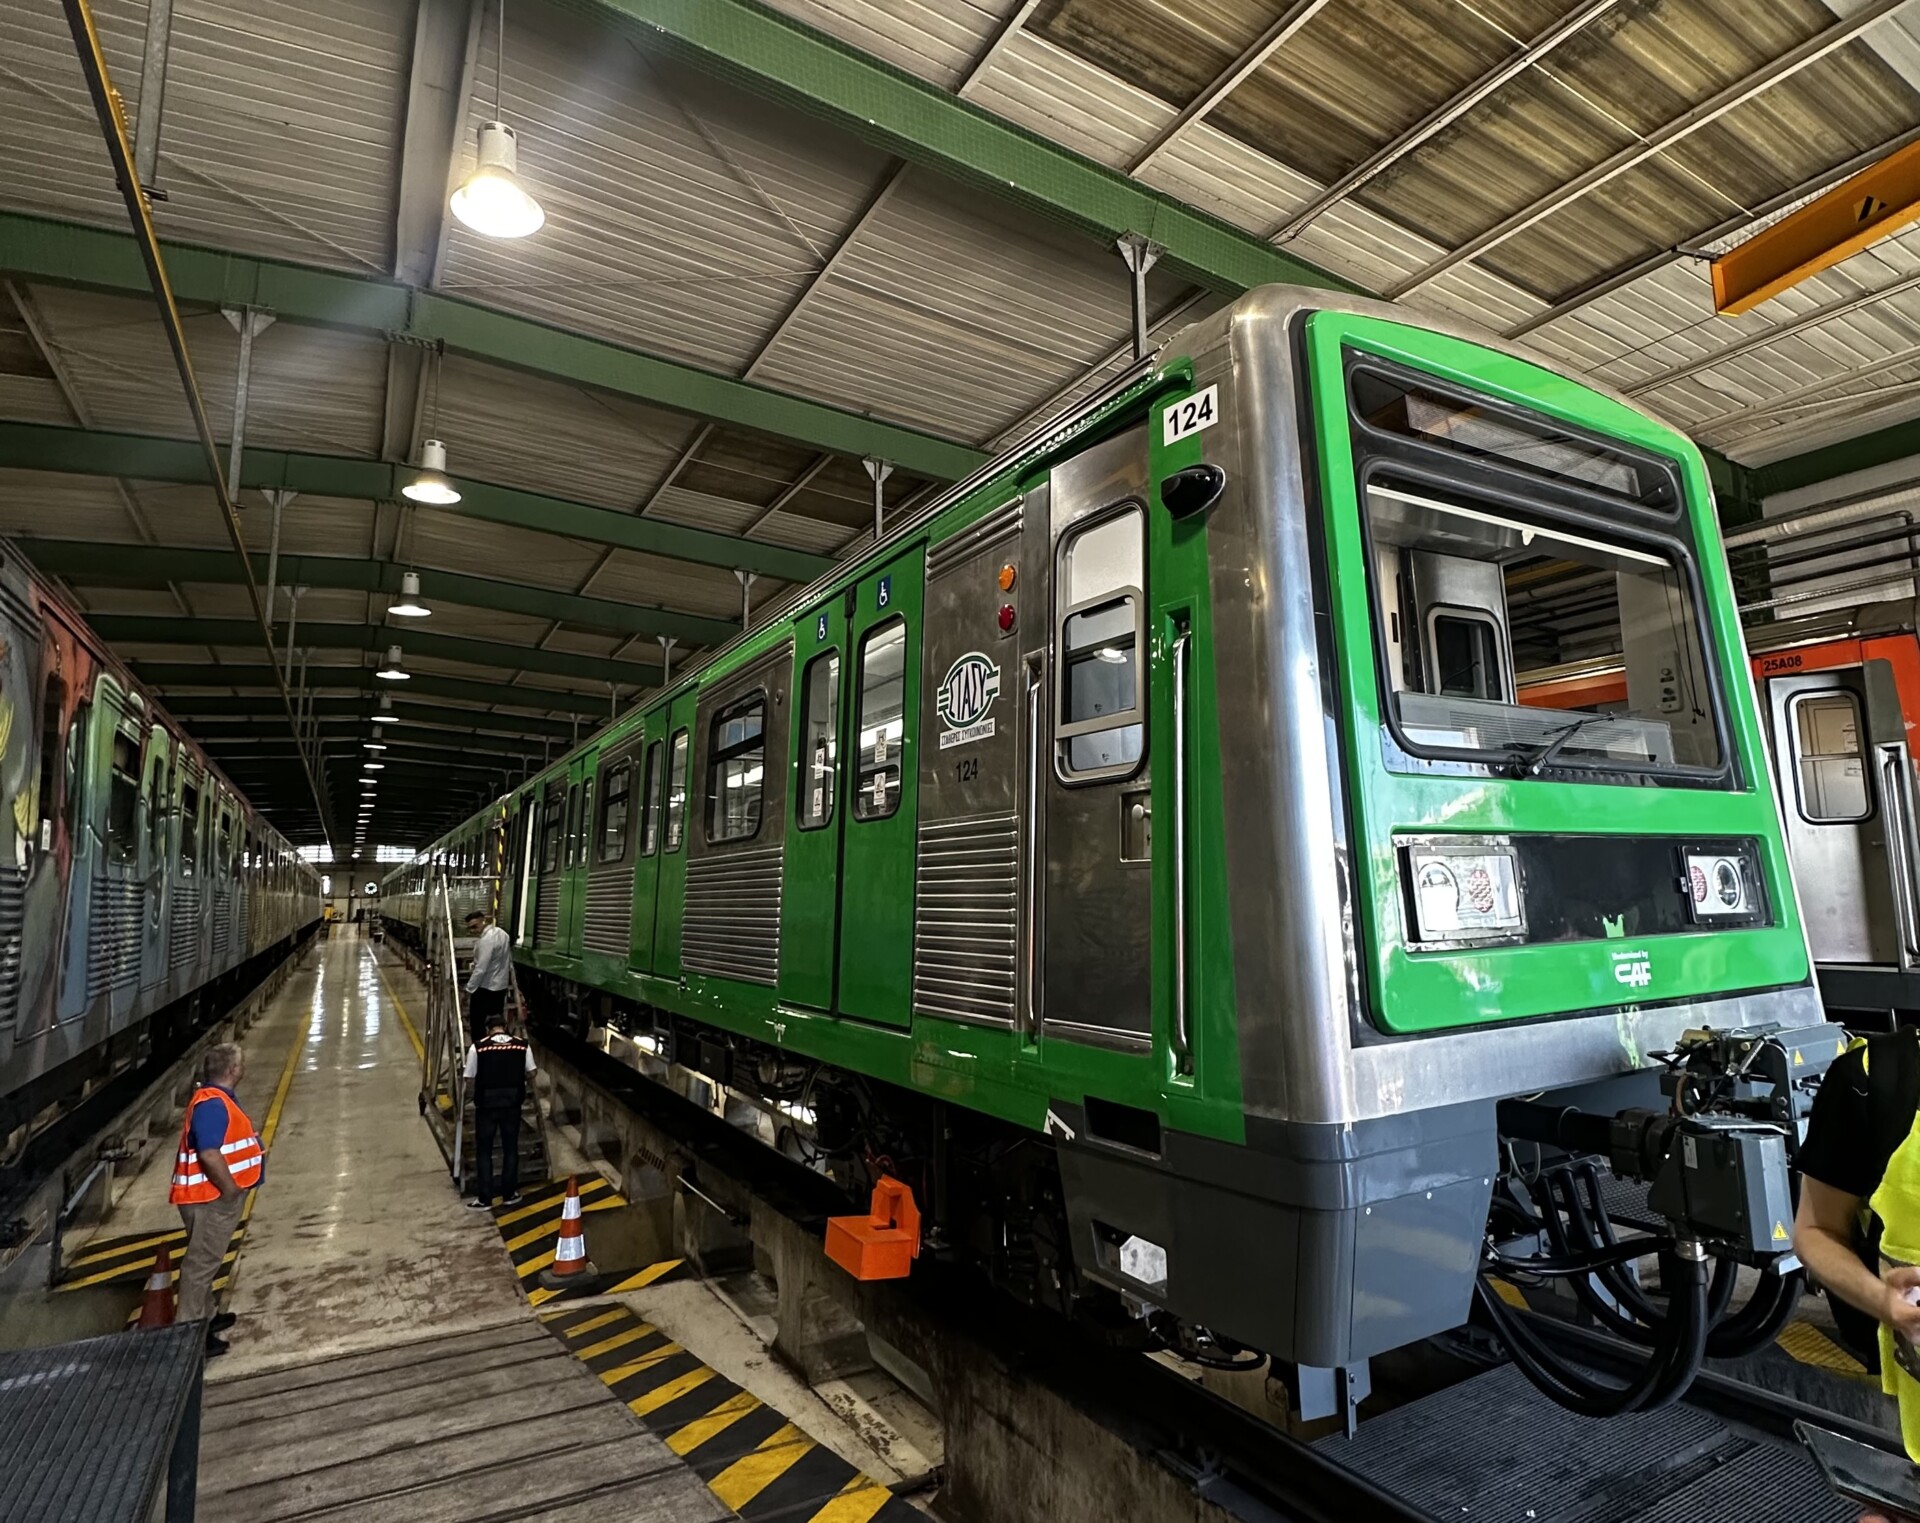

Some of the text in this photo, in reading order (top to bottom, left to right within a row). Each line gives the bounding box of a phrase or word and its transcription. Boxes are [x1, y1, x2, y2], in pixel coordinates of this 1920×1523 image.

[1169, 393, 1213, 436] 124
[1763, 655, 1802, 672] 25A08
[948, 662, 987, 721] ΣΤΑΣΥ
[955, 758, 979, 783] 124
[1614, 961, 1652, 988] CAF
